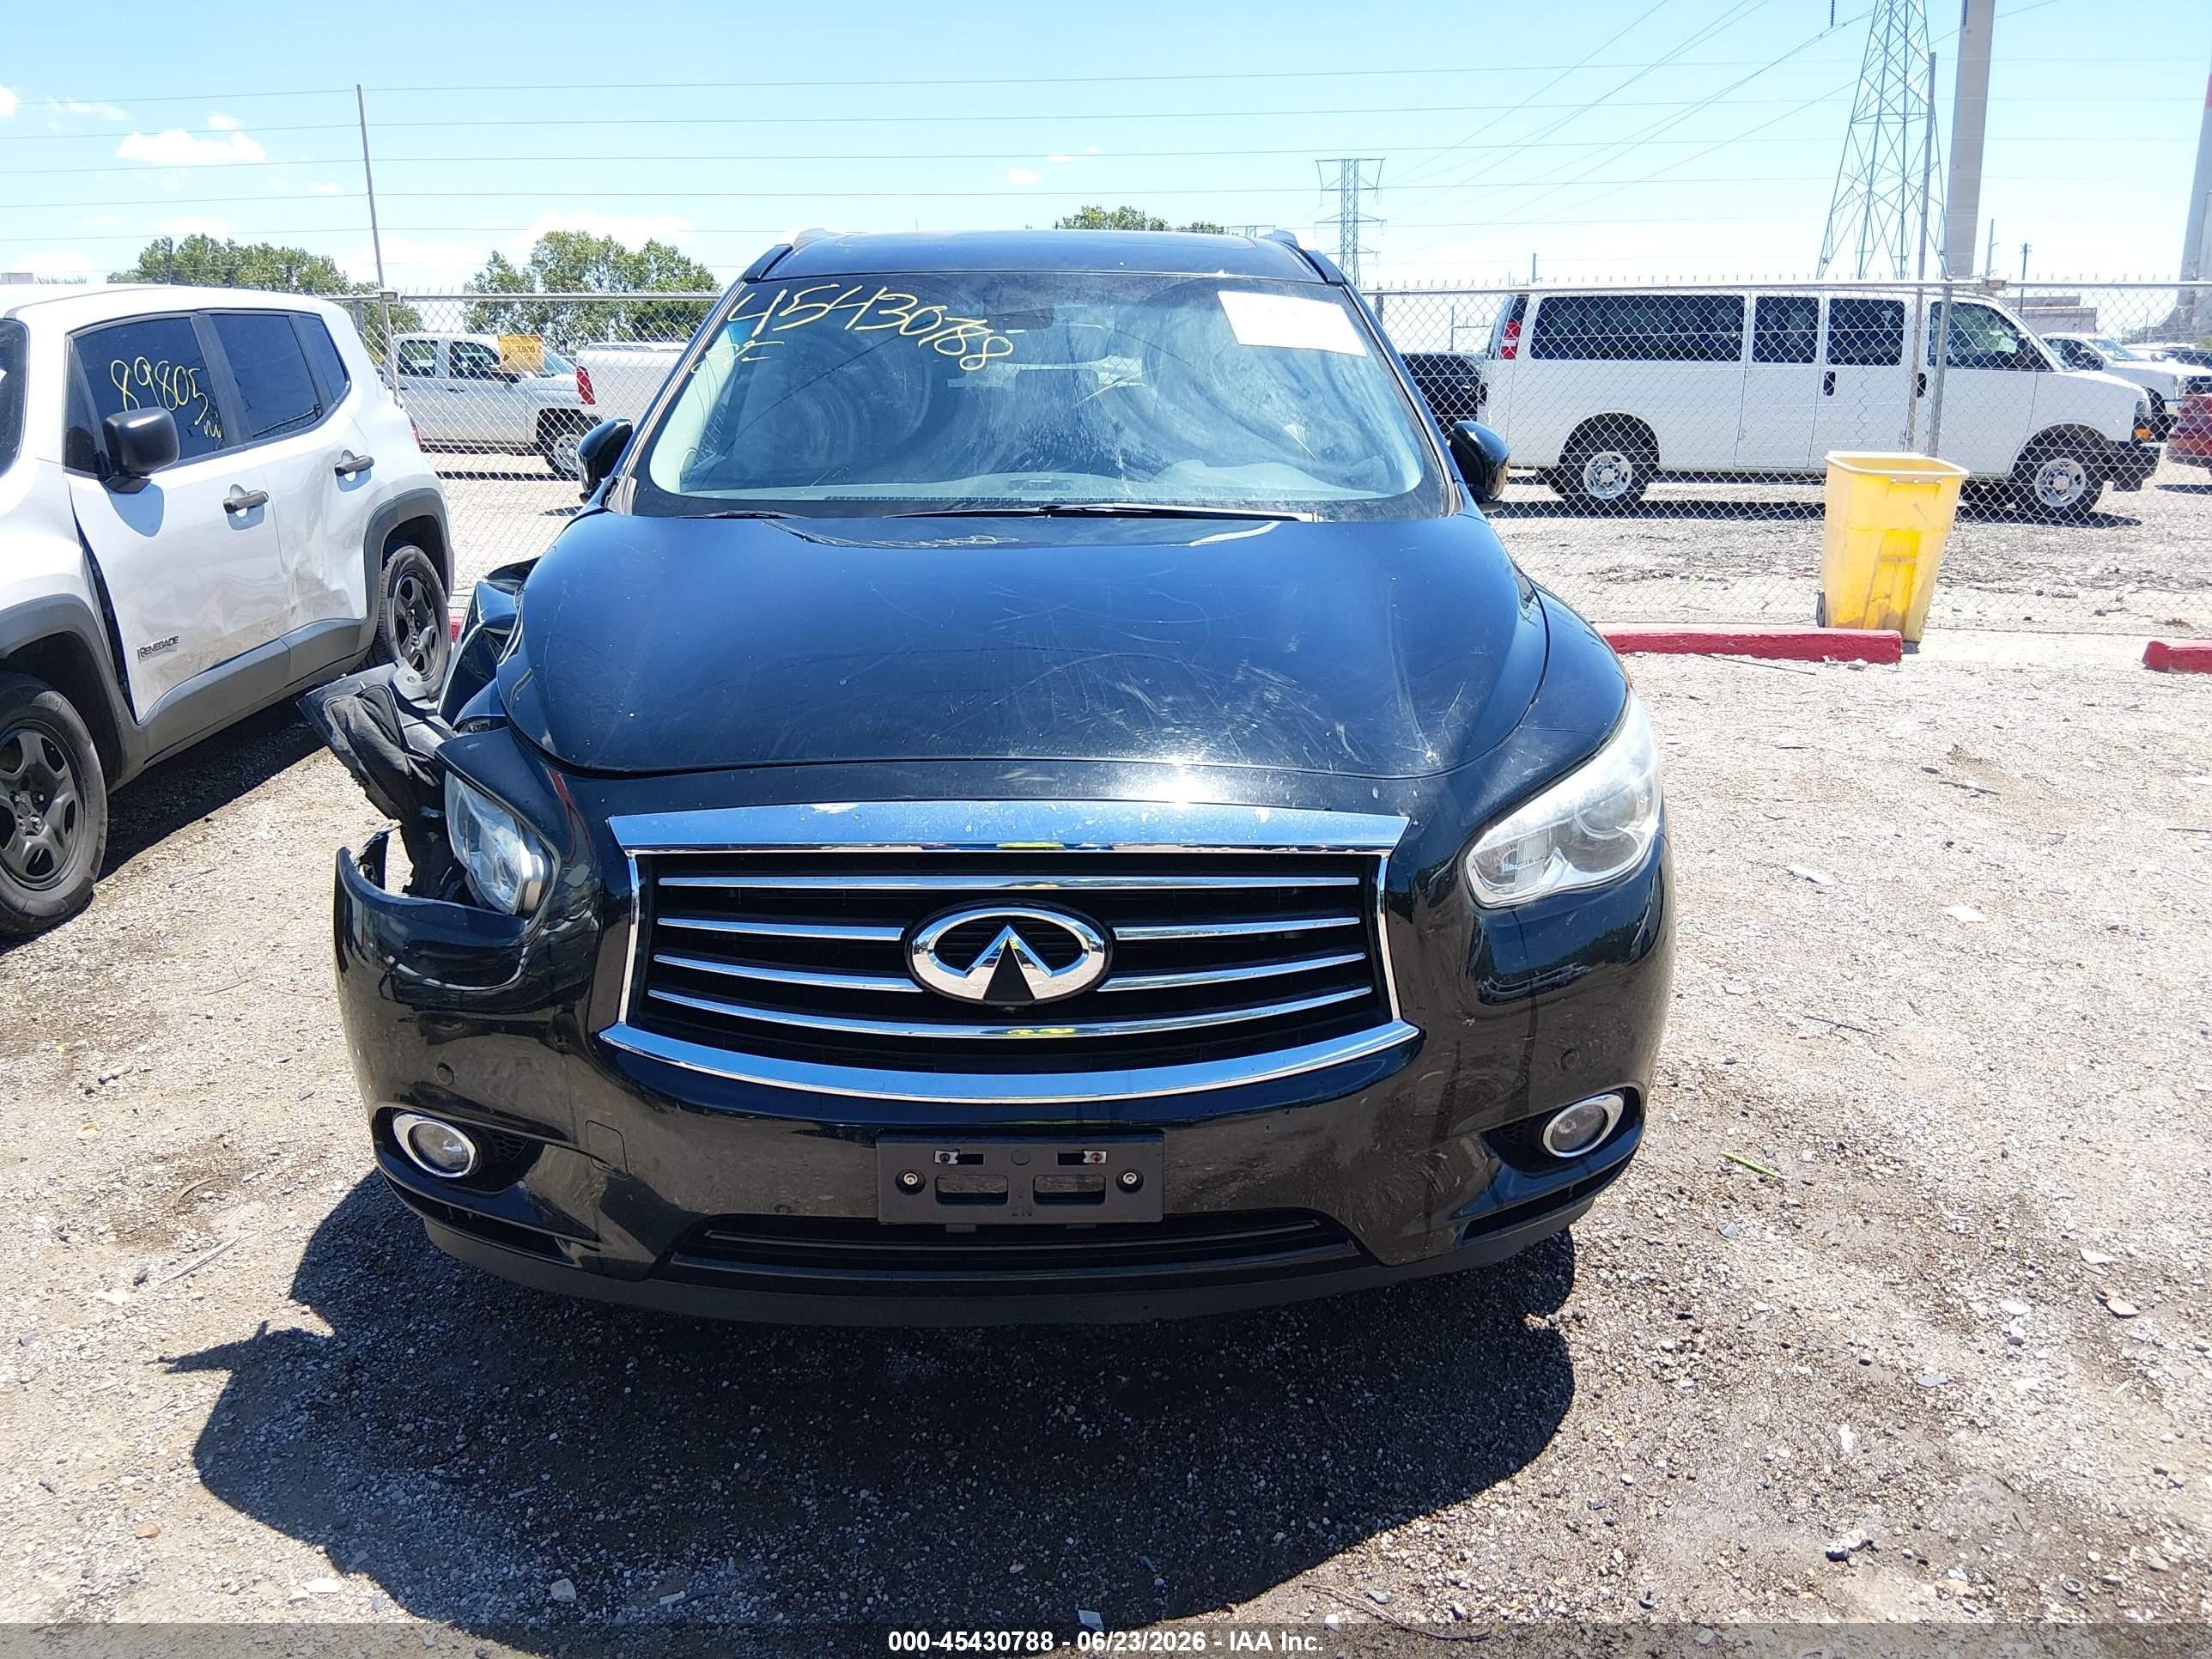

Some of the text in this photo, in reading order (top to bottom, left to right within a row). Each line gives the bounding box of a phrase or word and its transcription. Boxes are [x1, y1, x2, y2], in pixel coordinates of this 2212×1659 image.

[727, 283, 1014, 371] 45430788
[111, 356, 209, 426] 89805
[139, 635, 179, 658] RENEGADE
